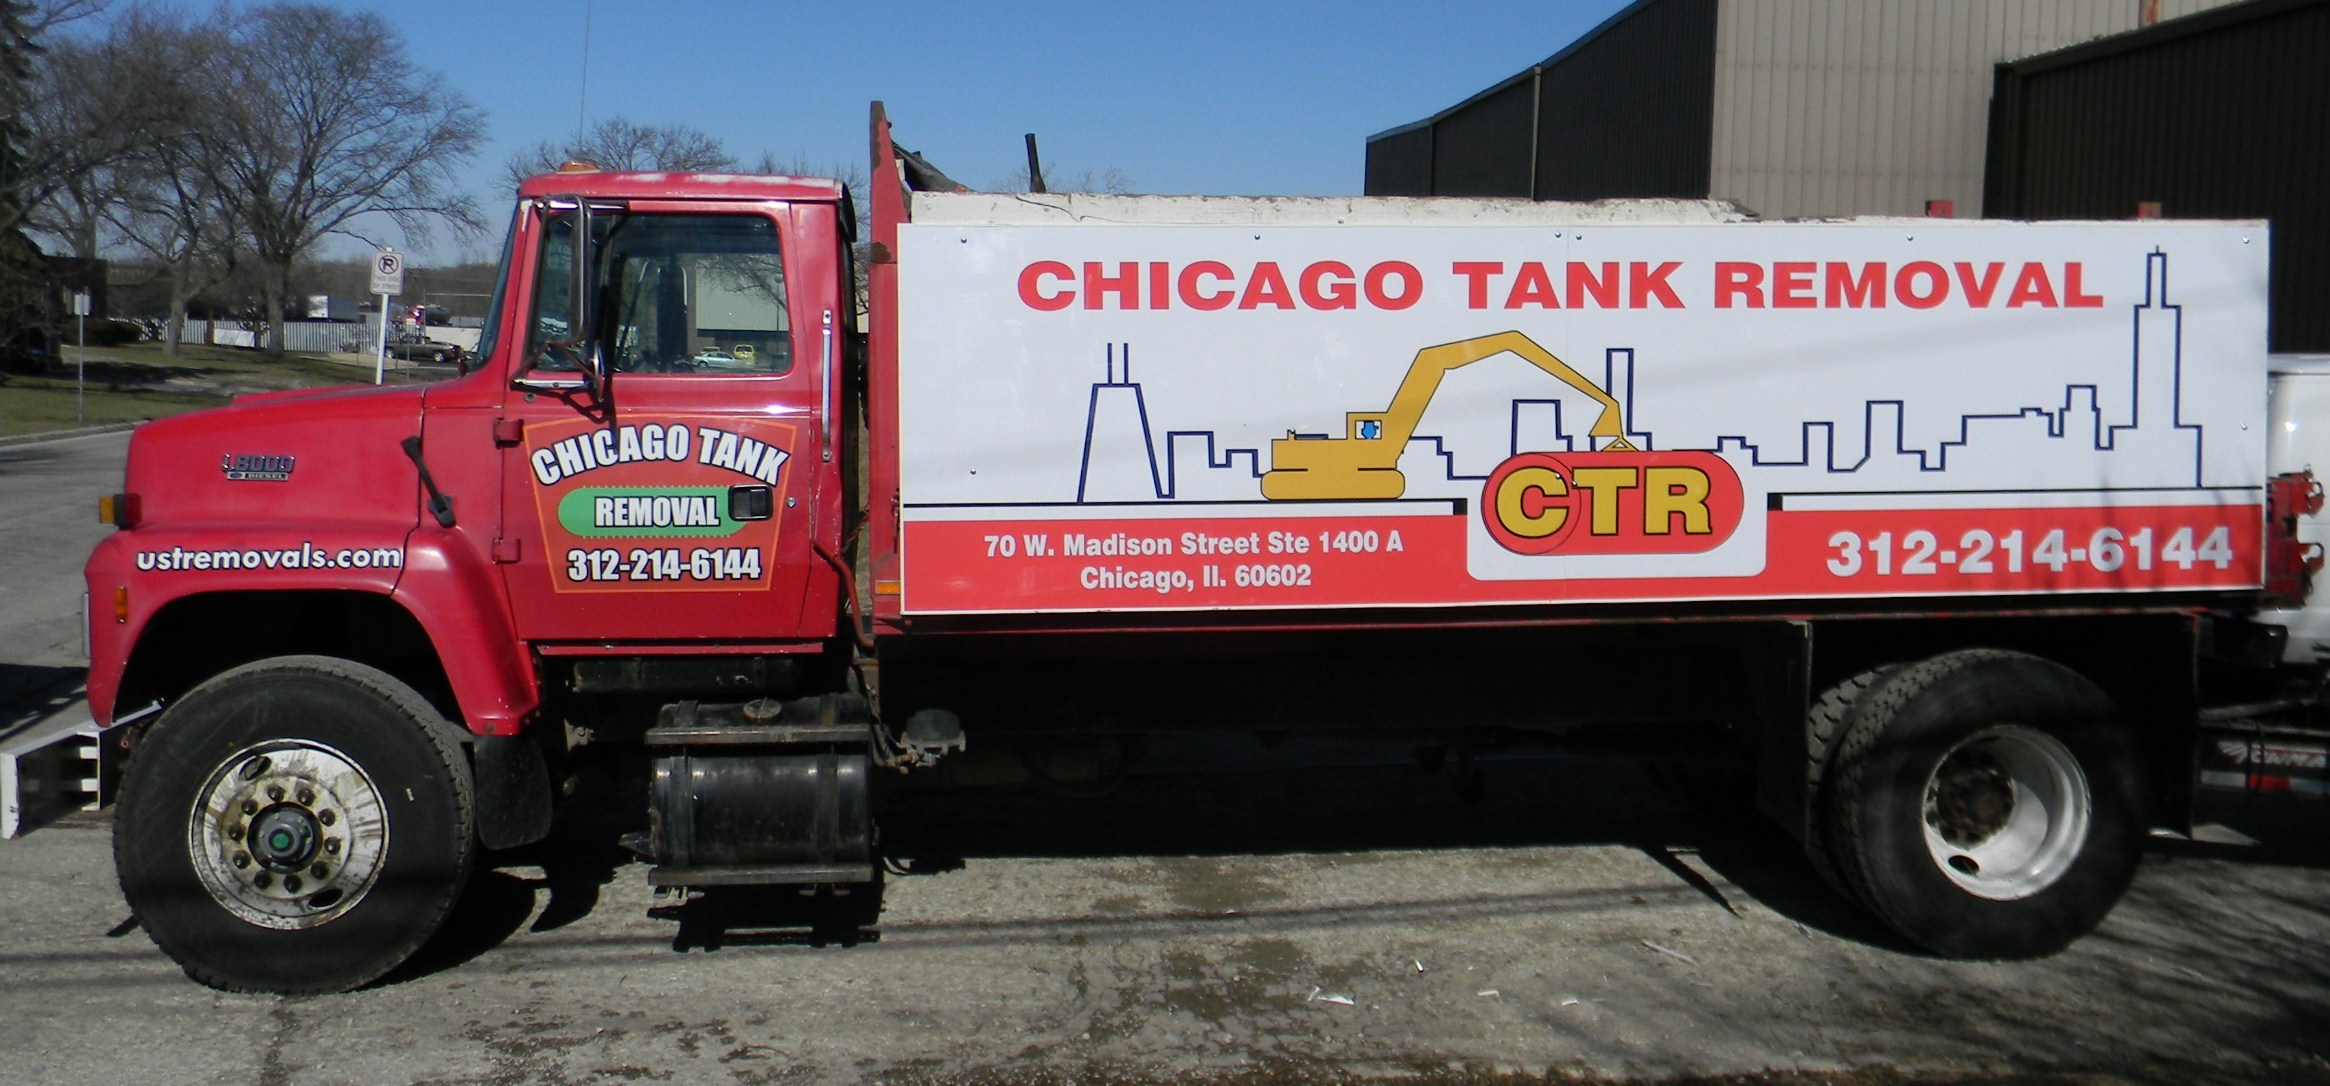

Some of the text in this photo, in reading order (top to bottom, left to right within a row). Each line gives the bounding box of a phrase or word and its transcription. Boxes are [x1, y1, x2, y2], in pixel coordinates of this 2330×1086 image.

[1017, 260, 2104, 311] CHICAGO TANK REMOVAL
[530, 423, 792, 487] CHICAGO TANK
[595, 495, 721, 528] REMOVAL
[1495, 465, 1713, 539] CTR
[136, 541, 402, 571] ustremovals.com
[984, 530, 1404, 557] 70 W. Madison Street Ste 1400 A
[1826, 526, 2233, 578] 312-214-6144
[567, 548, 762, 582] 312-214-6144
[1080, 566, 1194, 593] Chicago,
[1234, 564, 1312, 587] 60602
